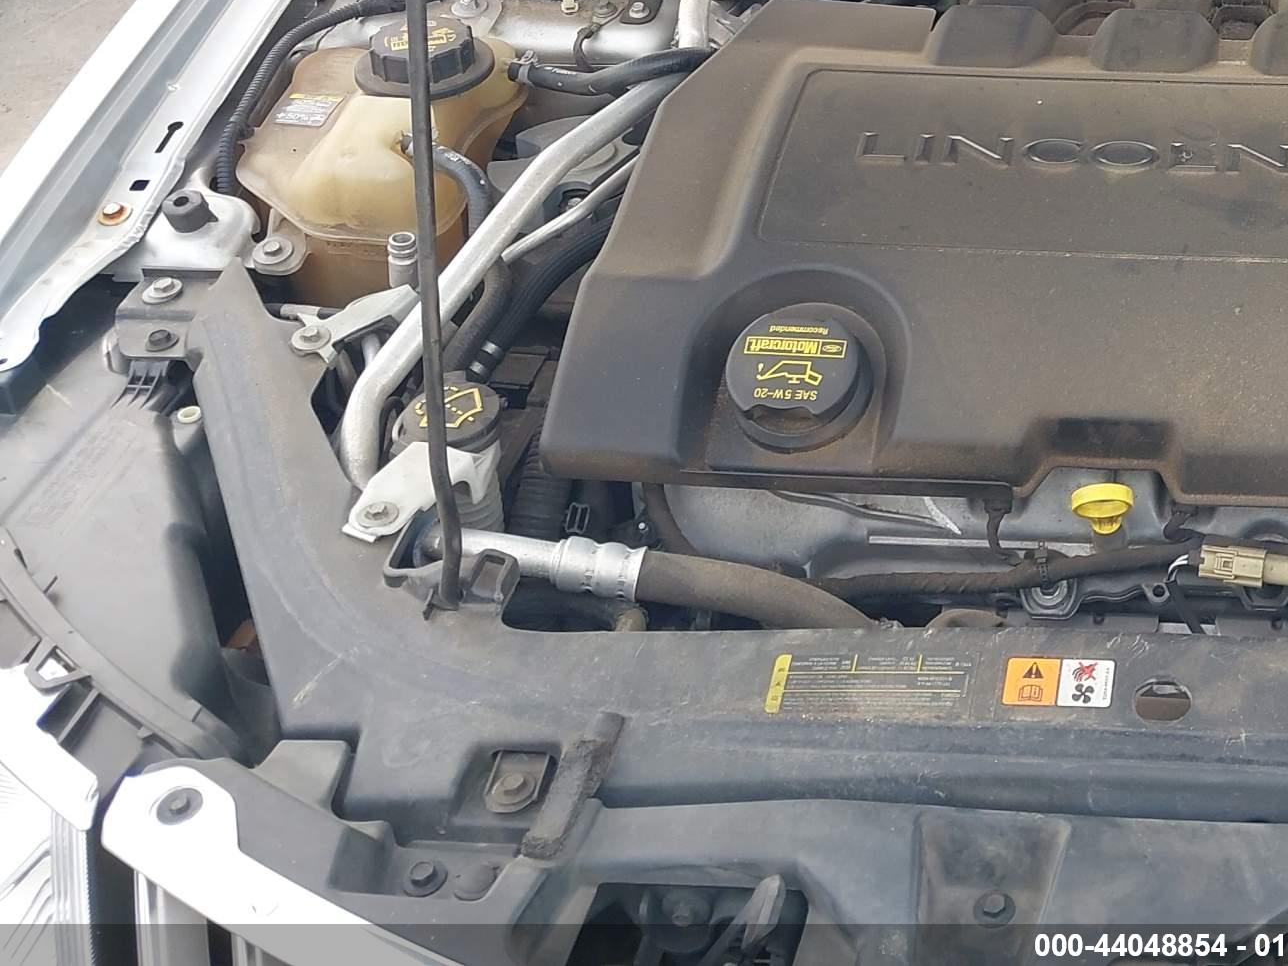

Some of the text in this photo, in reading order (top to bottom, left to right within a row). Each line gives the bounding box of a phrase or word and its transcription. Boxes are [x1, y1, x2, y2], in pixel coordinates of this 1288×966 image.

[768, 325, 830, 336] Recommended
[749, 338, 818, 355] Motorcraft
[753, 387, 818, 401] SAE 5W-20
